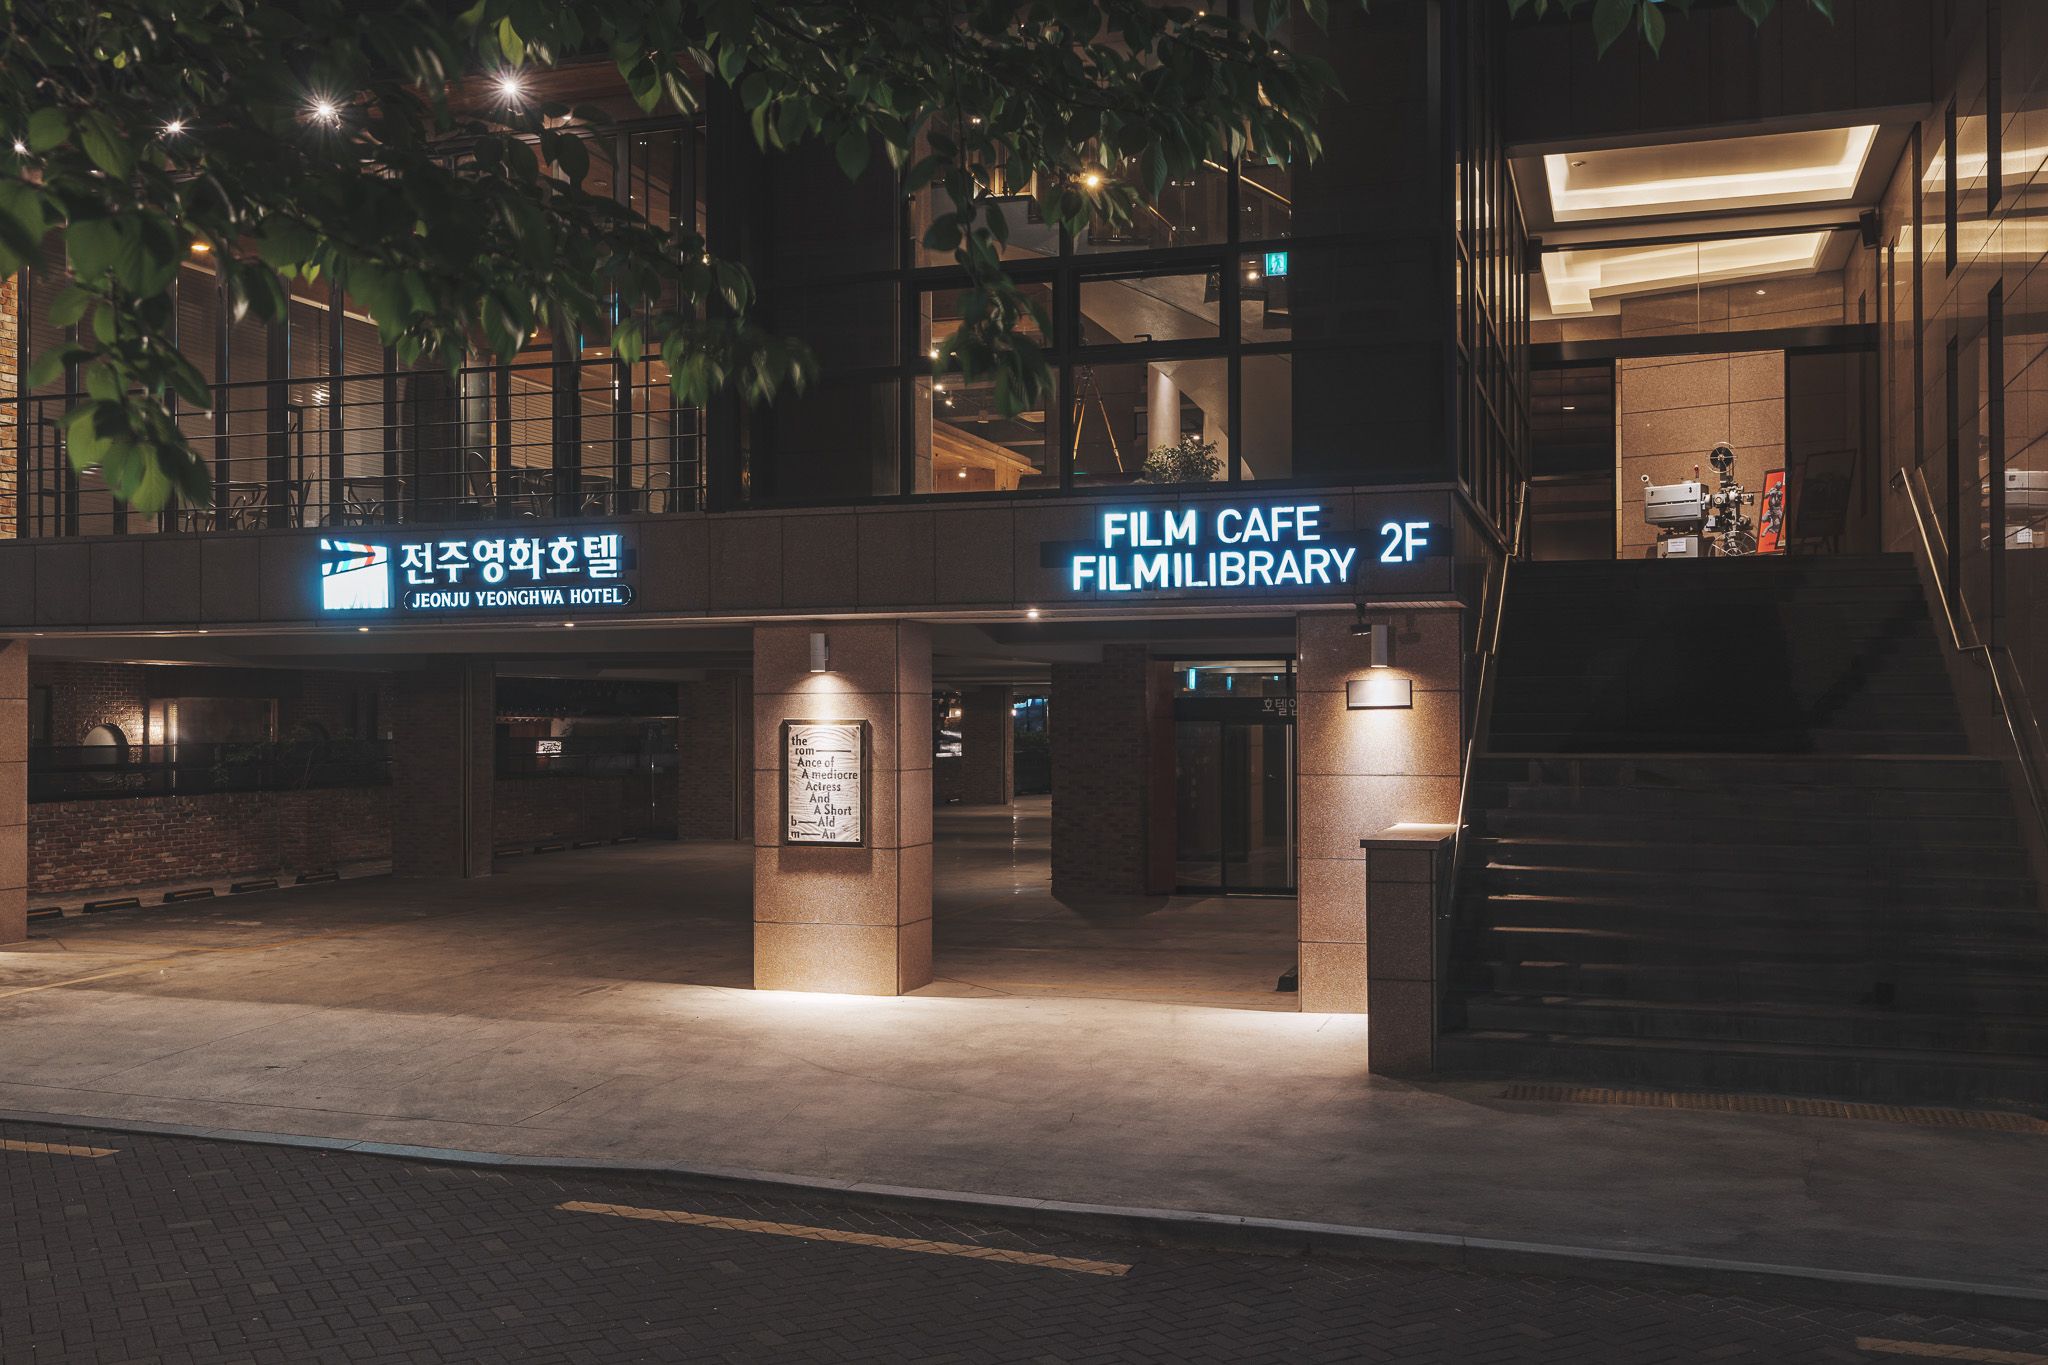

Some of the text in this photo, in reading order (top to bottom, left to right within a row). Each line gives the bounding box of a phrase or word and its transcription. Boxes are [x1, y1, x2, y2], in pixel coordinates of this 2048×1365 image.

[1104, 505, 1321, 549] FILM CAFE
[1379, 522, 1431, 563] 2F
[400, 533, 620, 584] 전주영화호텔
[411, 586, 623, 608] JEONJU YEONGHWA HOTEL
[791, 734, 808, 746] the
[797, 755, 835, 767] Ance of
[801, 769, 858, 780] A mediocre
[805, 781, 841, 792] Actress
[809, 792, 830, 803] And
[813, 803, 852, 816] A Short
[821, 828, 836, 840] An
